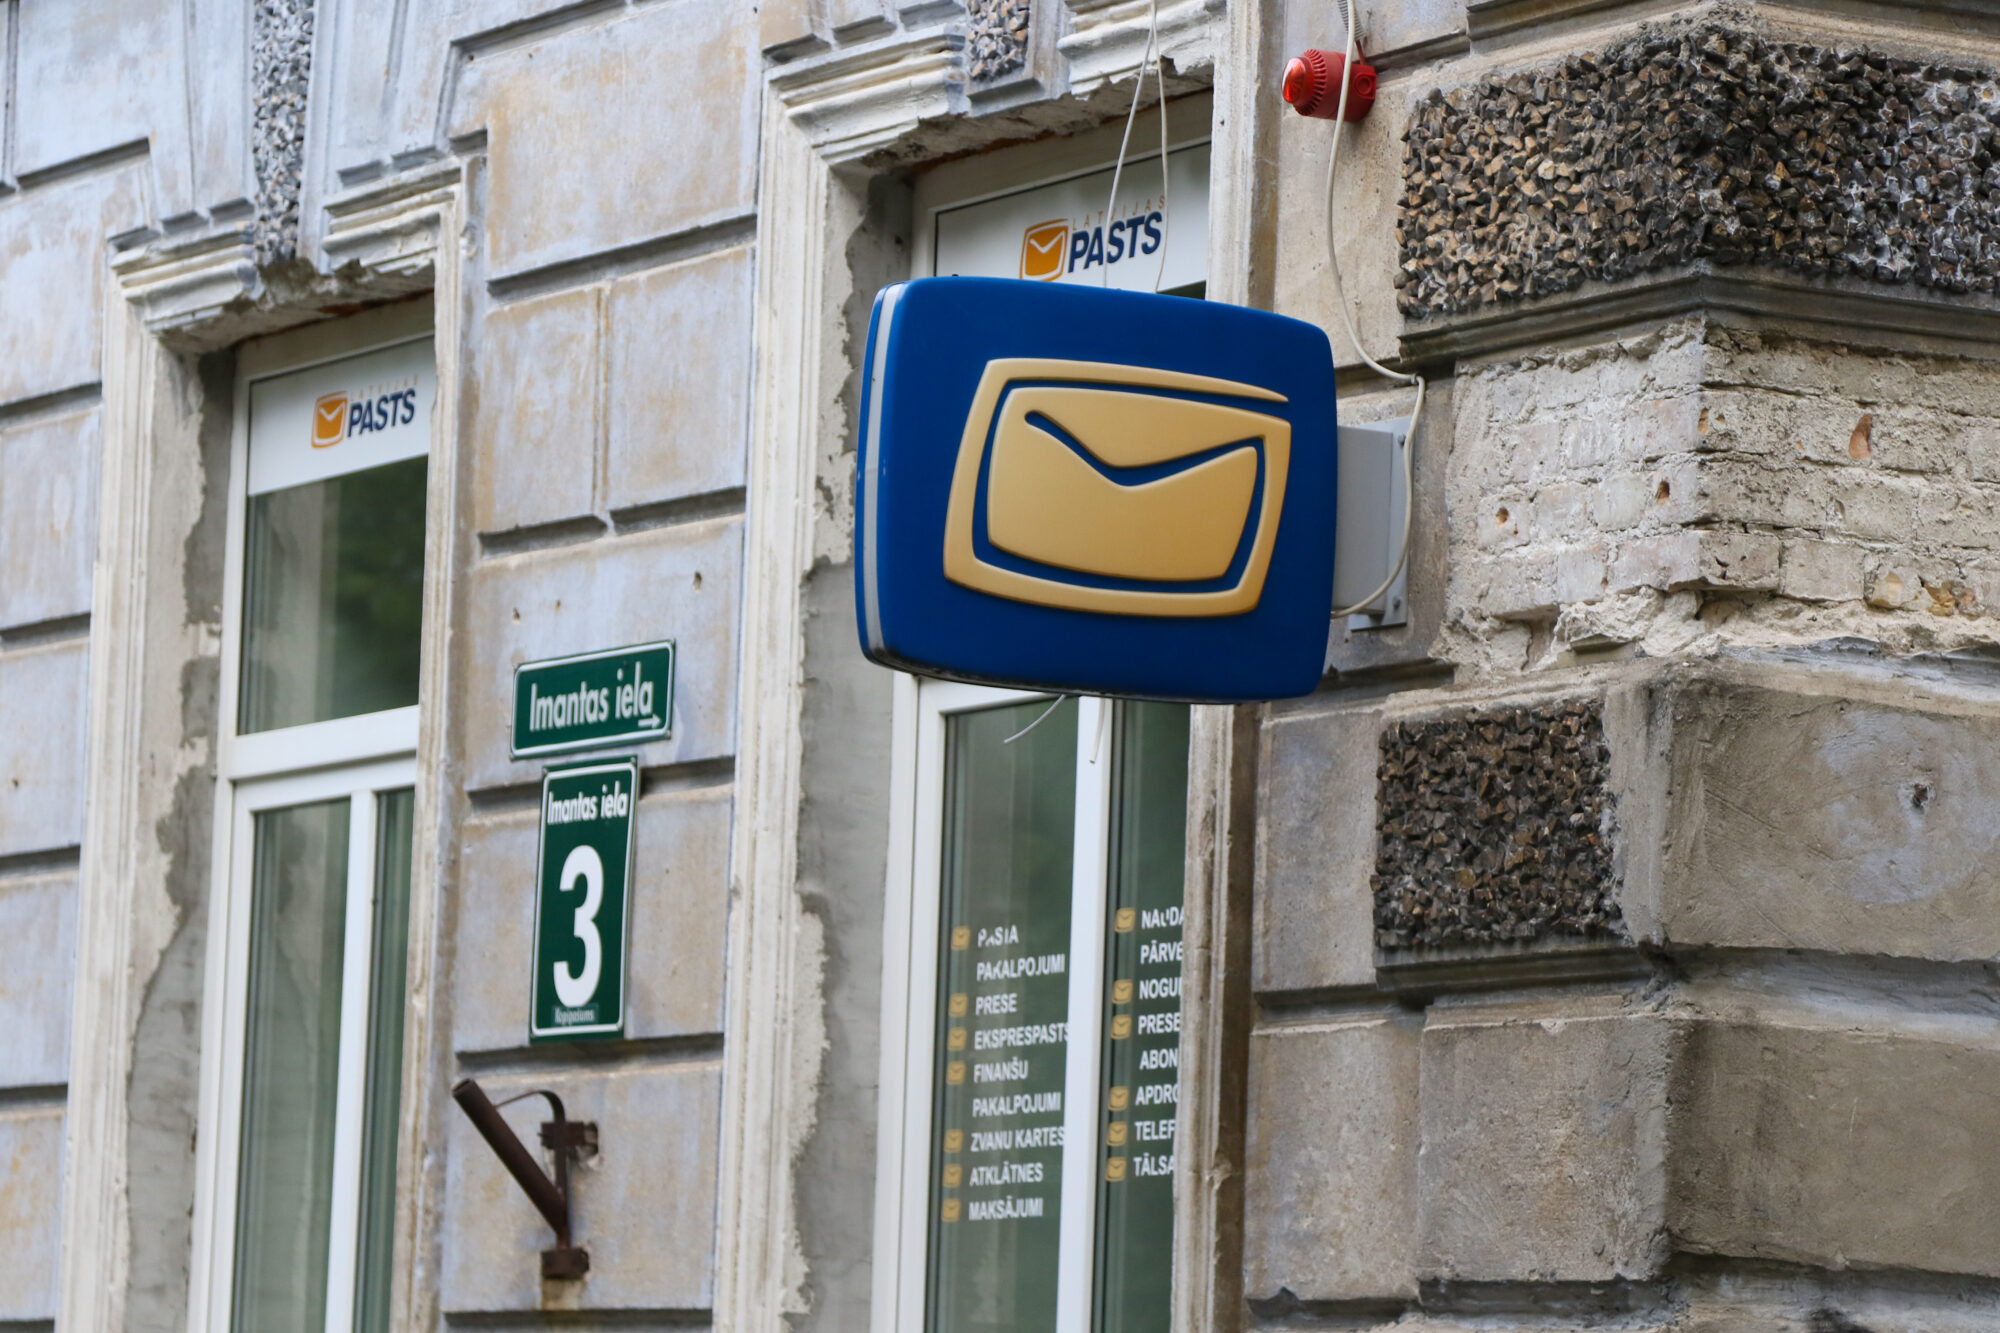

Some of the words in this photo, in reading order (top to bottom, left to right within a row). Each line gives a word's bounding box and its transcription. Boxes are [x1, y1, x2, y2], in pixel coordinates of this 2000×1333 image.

[1068, 211, 1162, 273] PASTS
[347, 387, 416, 438] PASTS
[529, 681, 609, 732] Imantas
[615, 661, 654, 720] iela
[547, 791, 598, 825] Imantas
[600, 780, 629, 818] iela
[553, 844, 604, 1008] 3
[976, 953, 1066, 982] PAKALPOJUMI
[975, 992, 1018, 1017] PRESE
[973, 1056, 1029, 1084] FINANŠU
[971, 1091, 1062, 1118] PAKALPOJUMI
[970, 1129, 1013, 1152] ZVANU
[1014, 1126, 1065, 1149] KARTES
[969, 1161, 1044, 1187] ATKLĀTNES
[968, 1195, 1044, 1221] MAKSĀJUMI
